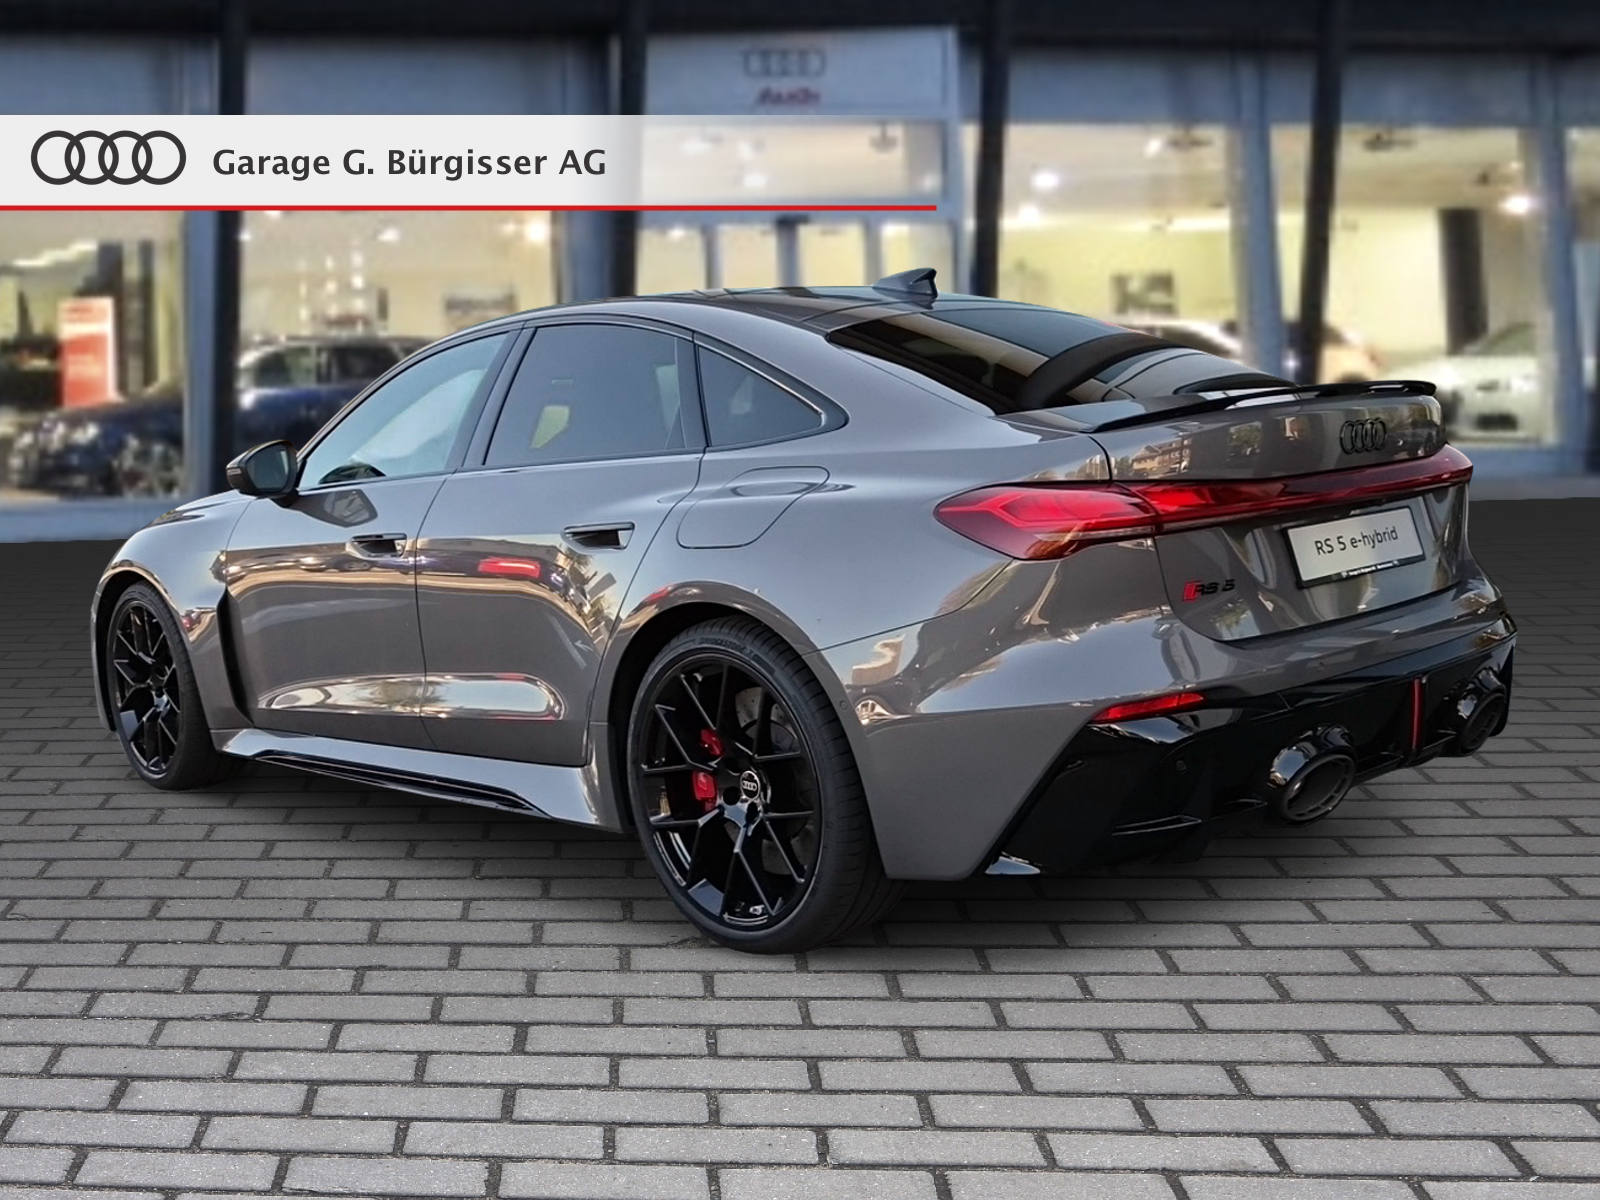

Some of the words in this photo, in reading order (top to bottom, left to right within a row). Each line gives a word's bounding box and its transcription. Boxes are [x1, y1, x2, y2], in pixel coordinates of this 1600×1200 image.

[1314, 537, 1335, 556] RS
[1336, 535, 1347, 552] 5
[1350, 525, 1399, 549] e-hybrid
[1222, 578, 1236, 592] 5
